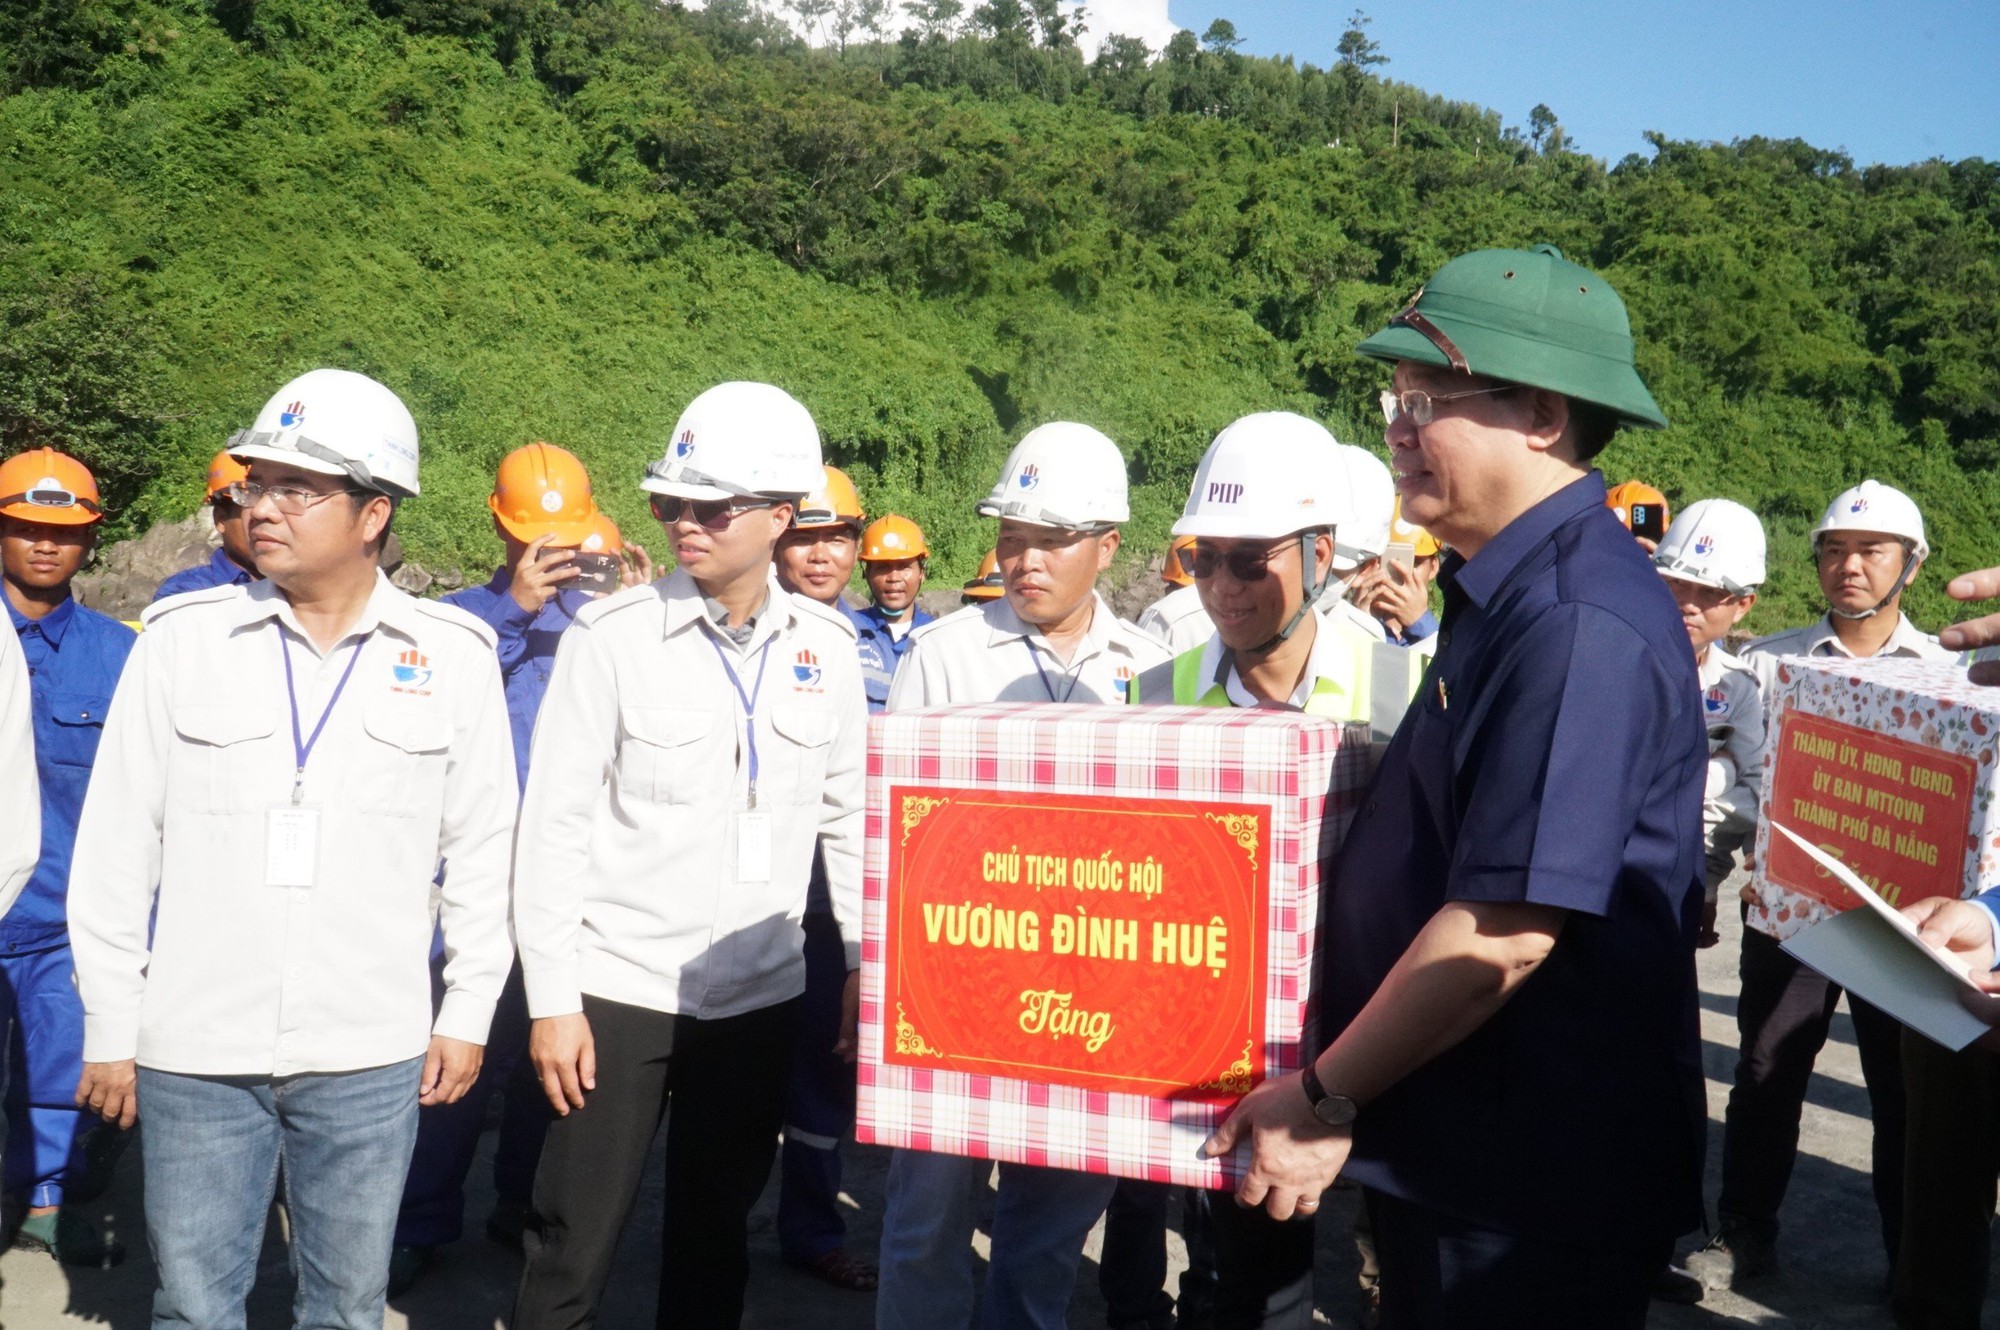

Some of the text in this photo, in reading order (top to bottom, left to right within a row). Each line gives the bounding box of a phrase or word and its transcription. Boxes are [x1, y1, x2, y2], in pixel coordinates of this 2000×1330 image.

[1792, 731, 1836, 761] THÀNH
[1839, 739, 1858, 770] ỦY,
[1910, 766, 1956, 800] UBND,
[1812, 765, 1925, 825] ỦY BAN MTTQVN
[1793, 799, 1838, 830] THÀNH
[1840, 815, 1870, 842] PHỐ
[1871, 825, 1890, 850] ĐÀ
[983, 845, 1163, 900] CHỦ TỊCH QUỐC HỘI
[923, 901, 1228, 979] VƯƠNG ĐÌNH HUỆ
[1019, 989, 1115, 1053] Tặng
